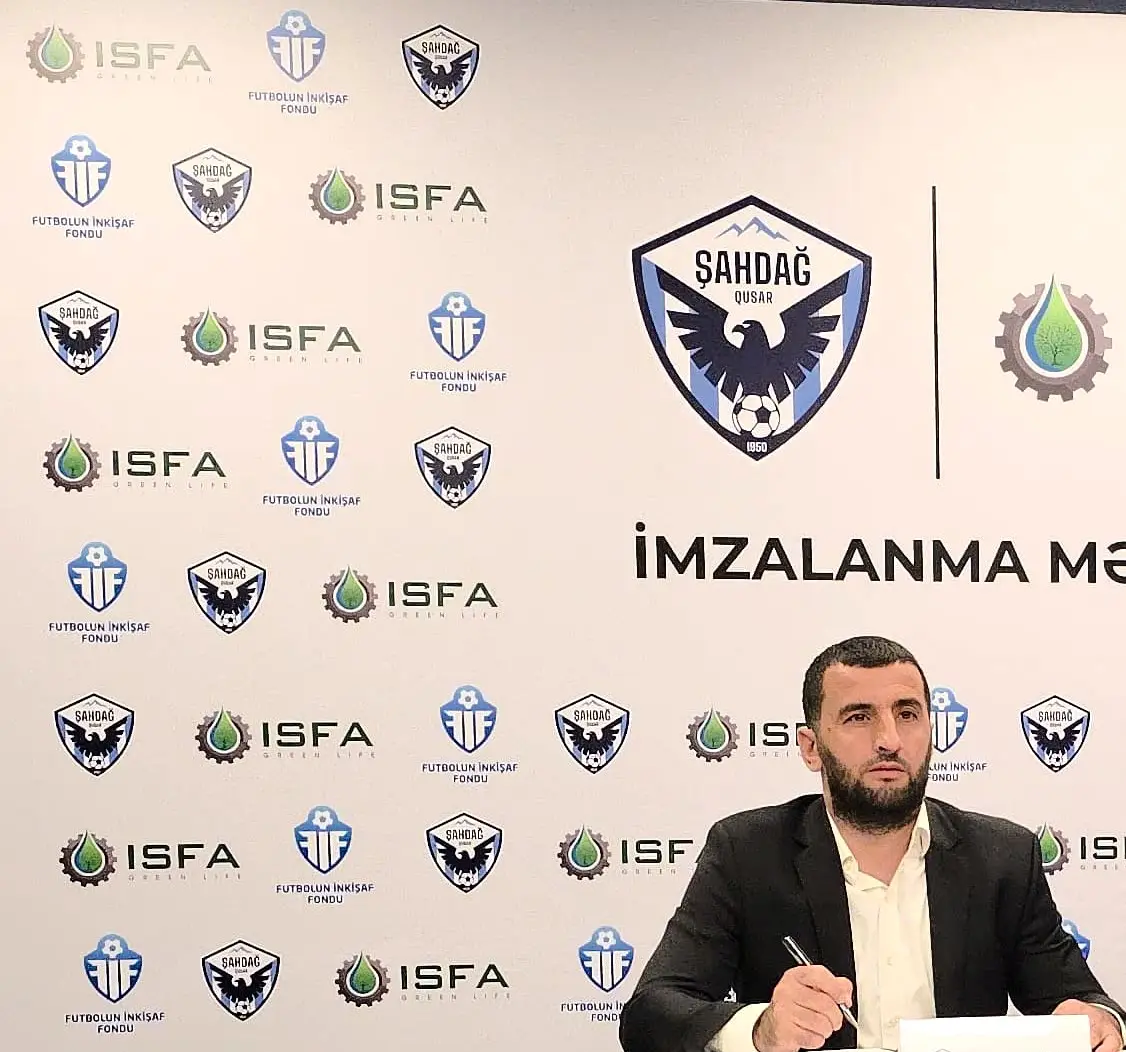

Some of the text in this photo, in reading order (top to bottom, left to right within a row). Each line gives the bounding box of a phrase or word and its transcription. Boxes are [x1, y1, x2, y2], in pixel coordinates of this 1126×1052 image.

[96, 41, 211, 71] ISFA
[248, 91, 304, 103] FUTBOLUN
[280, 104, 317, 115] FONDU
[376, 184, 486, 212] ISFA
[32, 216, 89, 227] FUTBOLUN
[65, 228, 103, 239] FONDU
[696, 246, 811, 289] ŞAHDAĞ
[735, 291, 772, 304] QUSAR
[249, 325, 361, 352] ISFA
[409, 370, 464, 381] FUTBOLUN
[441, 382, 477, 393] FONDU
[746, 441, 767, 452] 1950
[113, 451, 226, 477] ISFA
[262, 495, 318, 505] FUTBOLUN
[294, 507, 330, 517] FONDU
[636, 522, 1029, 582] İMZALANMA
[389, 582, 498, 607] ISFA
[48, 622, 105, 632] FUTBOLUN
[81, 633, 119, 643] FONDU
[263, 722, 373, 747] ISFA
[750, 723, 806, 746] IS
[422, 763, 476, 773] FUTBOLUN
[453, 774, 488, 783] FONDU
[128, 844, 240, 869] ISFA
[622, 840, 699, 863] ISF
[276, 884, 331, 894] FUTBOLUN
[307, 894, 343, 904] FONDU
[401, 964, 509, 990] ISFA
[560, 1002, 613, 1012] FUTBOLUN
[65, 1013, 121, 1024] FUTBOLUN
[592, 1013, 619, 1021] FOND
[97, 1024, 134, 1034] FONDU
